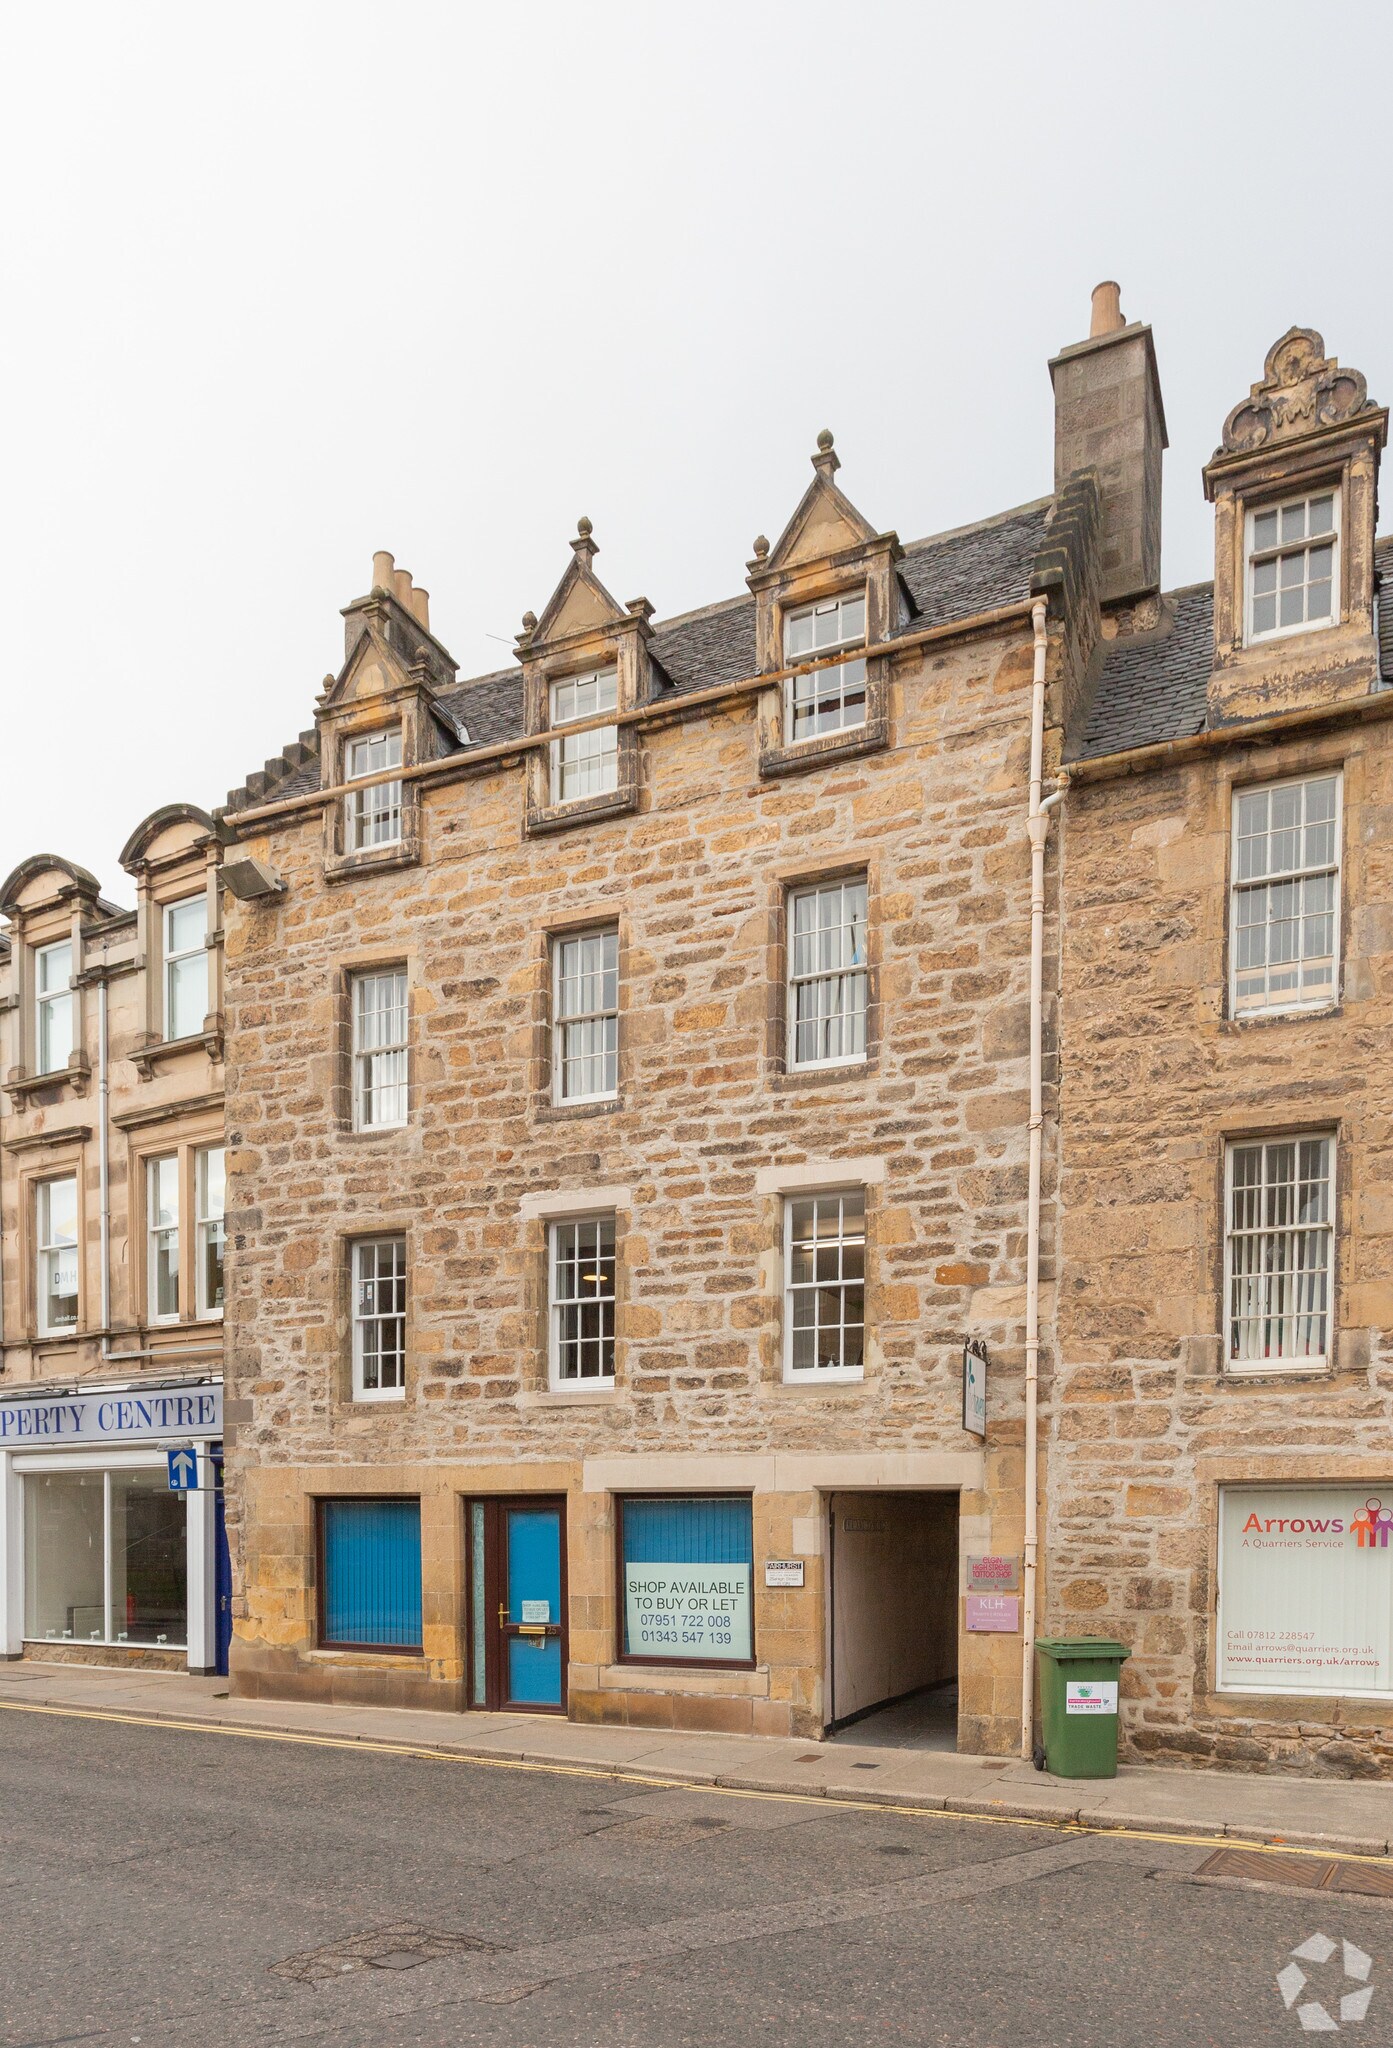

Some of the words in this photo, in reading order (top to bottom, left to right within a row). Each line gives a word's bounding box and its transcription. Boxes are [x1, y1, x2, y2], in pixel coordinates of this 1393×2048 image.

[0, 1404, 86, 1437] PERTY
[97, 1394, 216, 1431] CENTRE
[1242, 1513, 1344, 1533] Arrows
[1242, 1539, 1249, 1548] A
[1253, 1538, 1302, 1549] Quarriers
[1305, 1539, 1344, 1548] Service
[628, 1581, 667, 1593] SHOP
[669, 1582, 745, 1594] AVAILABLE
[634, 1597, 653, 1609] TO
[656, 1598, 684, 1610] BUY
[688, 1598, 708, 1610] OR
[713, 1599, 738, 1611] LET
[640, 1614, 676, 1626] 07951
[681, 1615, 704, 1627] 722
[707, 1615, 731, 1628] 008
[641, 1630, 678, 1643] 01343
[682, 1631, 704, 1643] 547
[708, 1632, 732, 1644] 139
[1227, 1630, 1245, 1639] Call
[1247, 1631, 1276, 1640] 07812
[1279, 1631, 1315, 1640] 228547
[1227, 1642, 1253, 1651] Email
[1255, 1644, 1374, 1656] arrows@quarriers.org.uk
[1226, 1655, 1380, 1667] www.quarriers.org.uk/arrows
